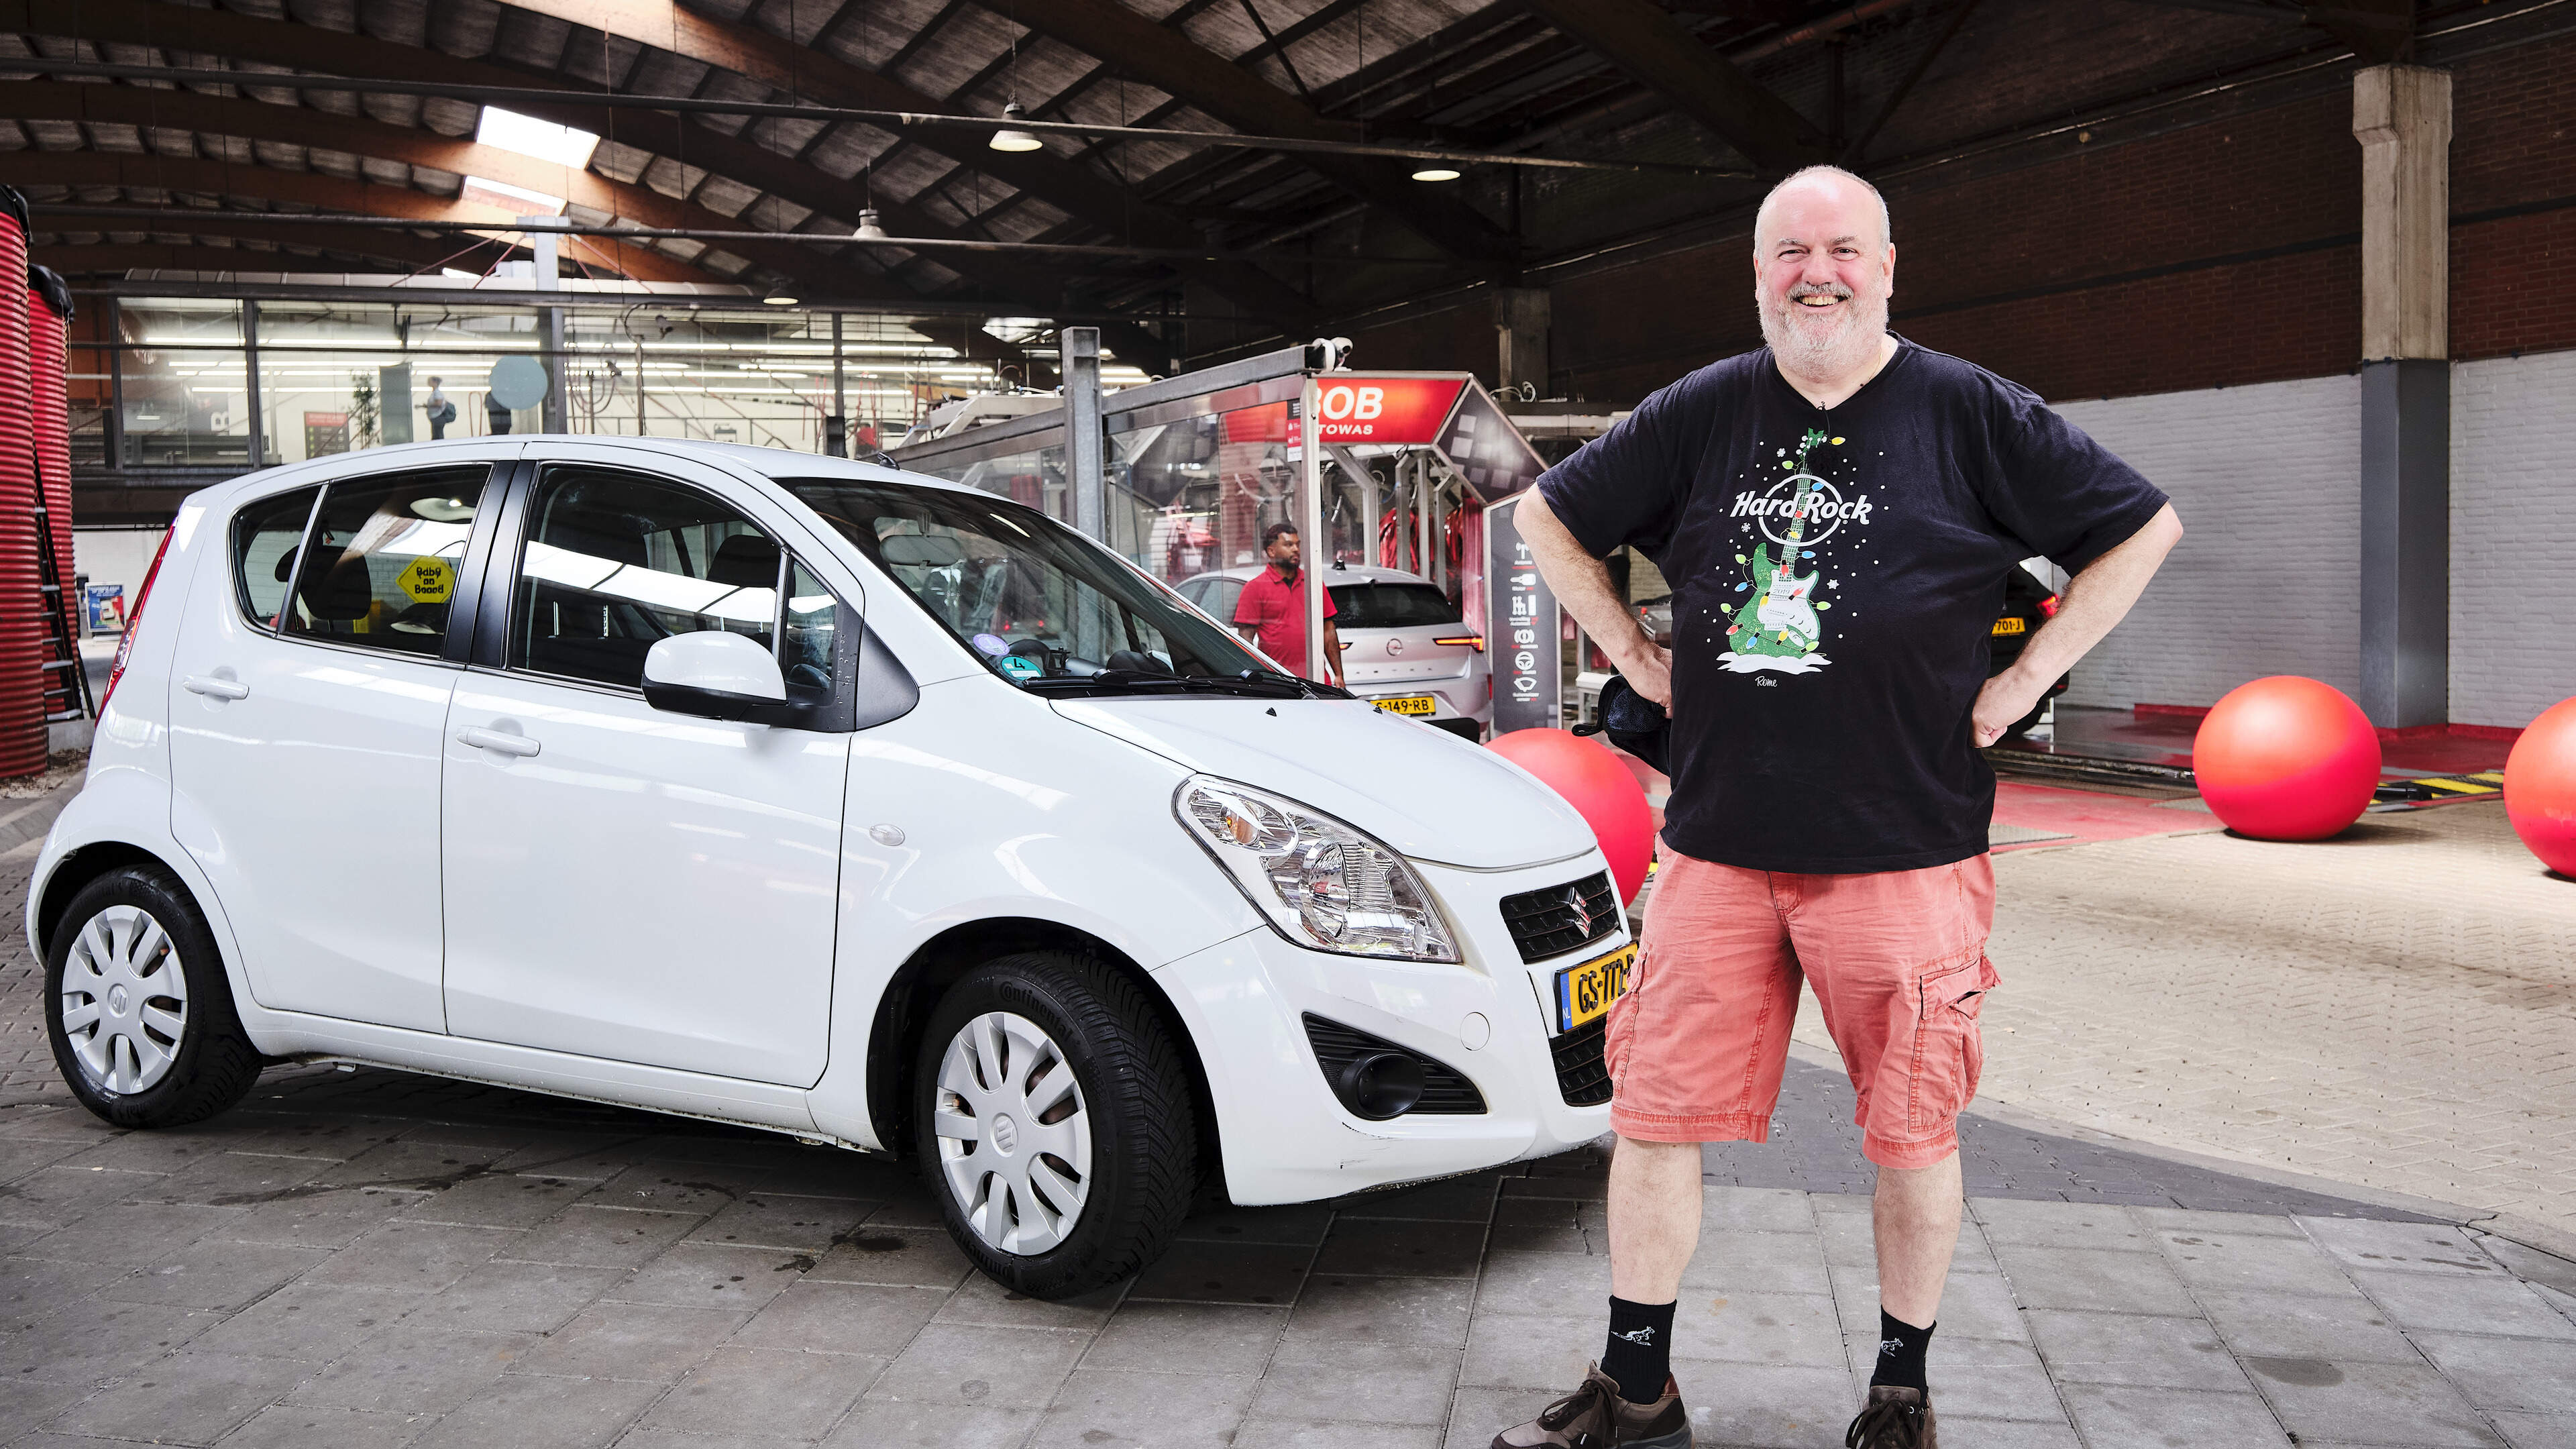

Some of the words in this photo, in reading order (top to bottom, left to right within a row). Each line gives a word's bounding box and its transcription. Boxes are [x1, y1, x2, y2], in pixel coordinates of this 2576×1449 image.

[1317, 386, 1383, 420] OB
[1318, 424, 1373, 435] TOWAS
[1729, 490, 1804, 518] Hard
[1802, 492, 1873, 525] Rock
[1994, 620, 2020, 631] -701-J
[1014, 658, 1025, 669] 4
[1755, 676, 1778, 688] Rome
[999, 981, 1074, 1042] Continental
[1562, 1007, 1570, 1020] NL
